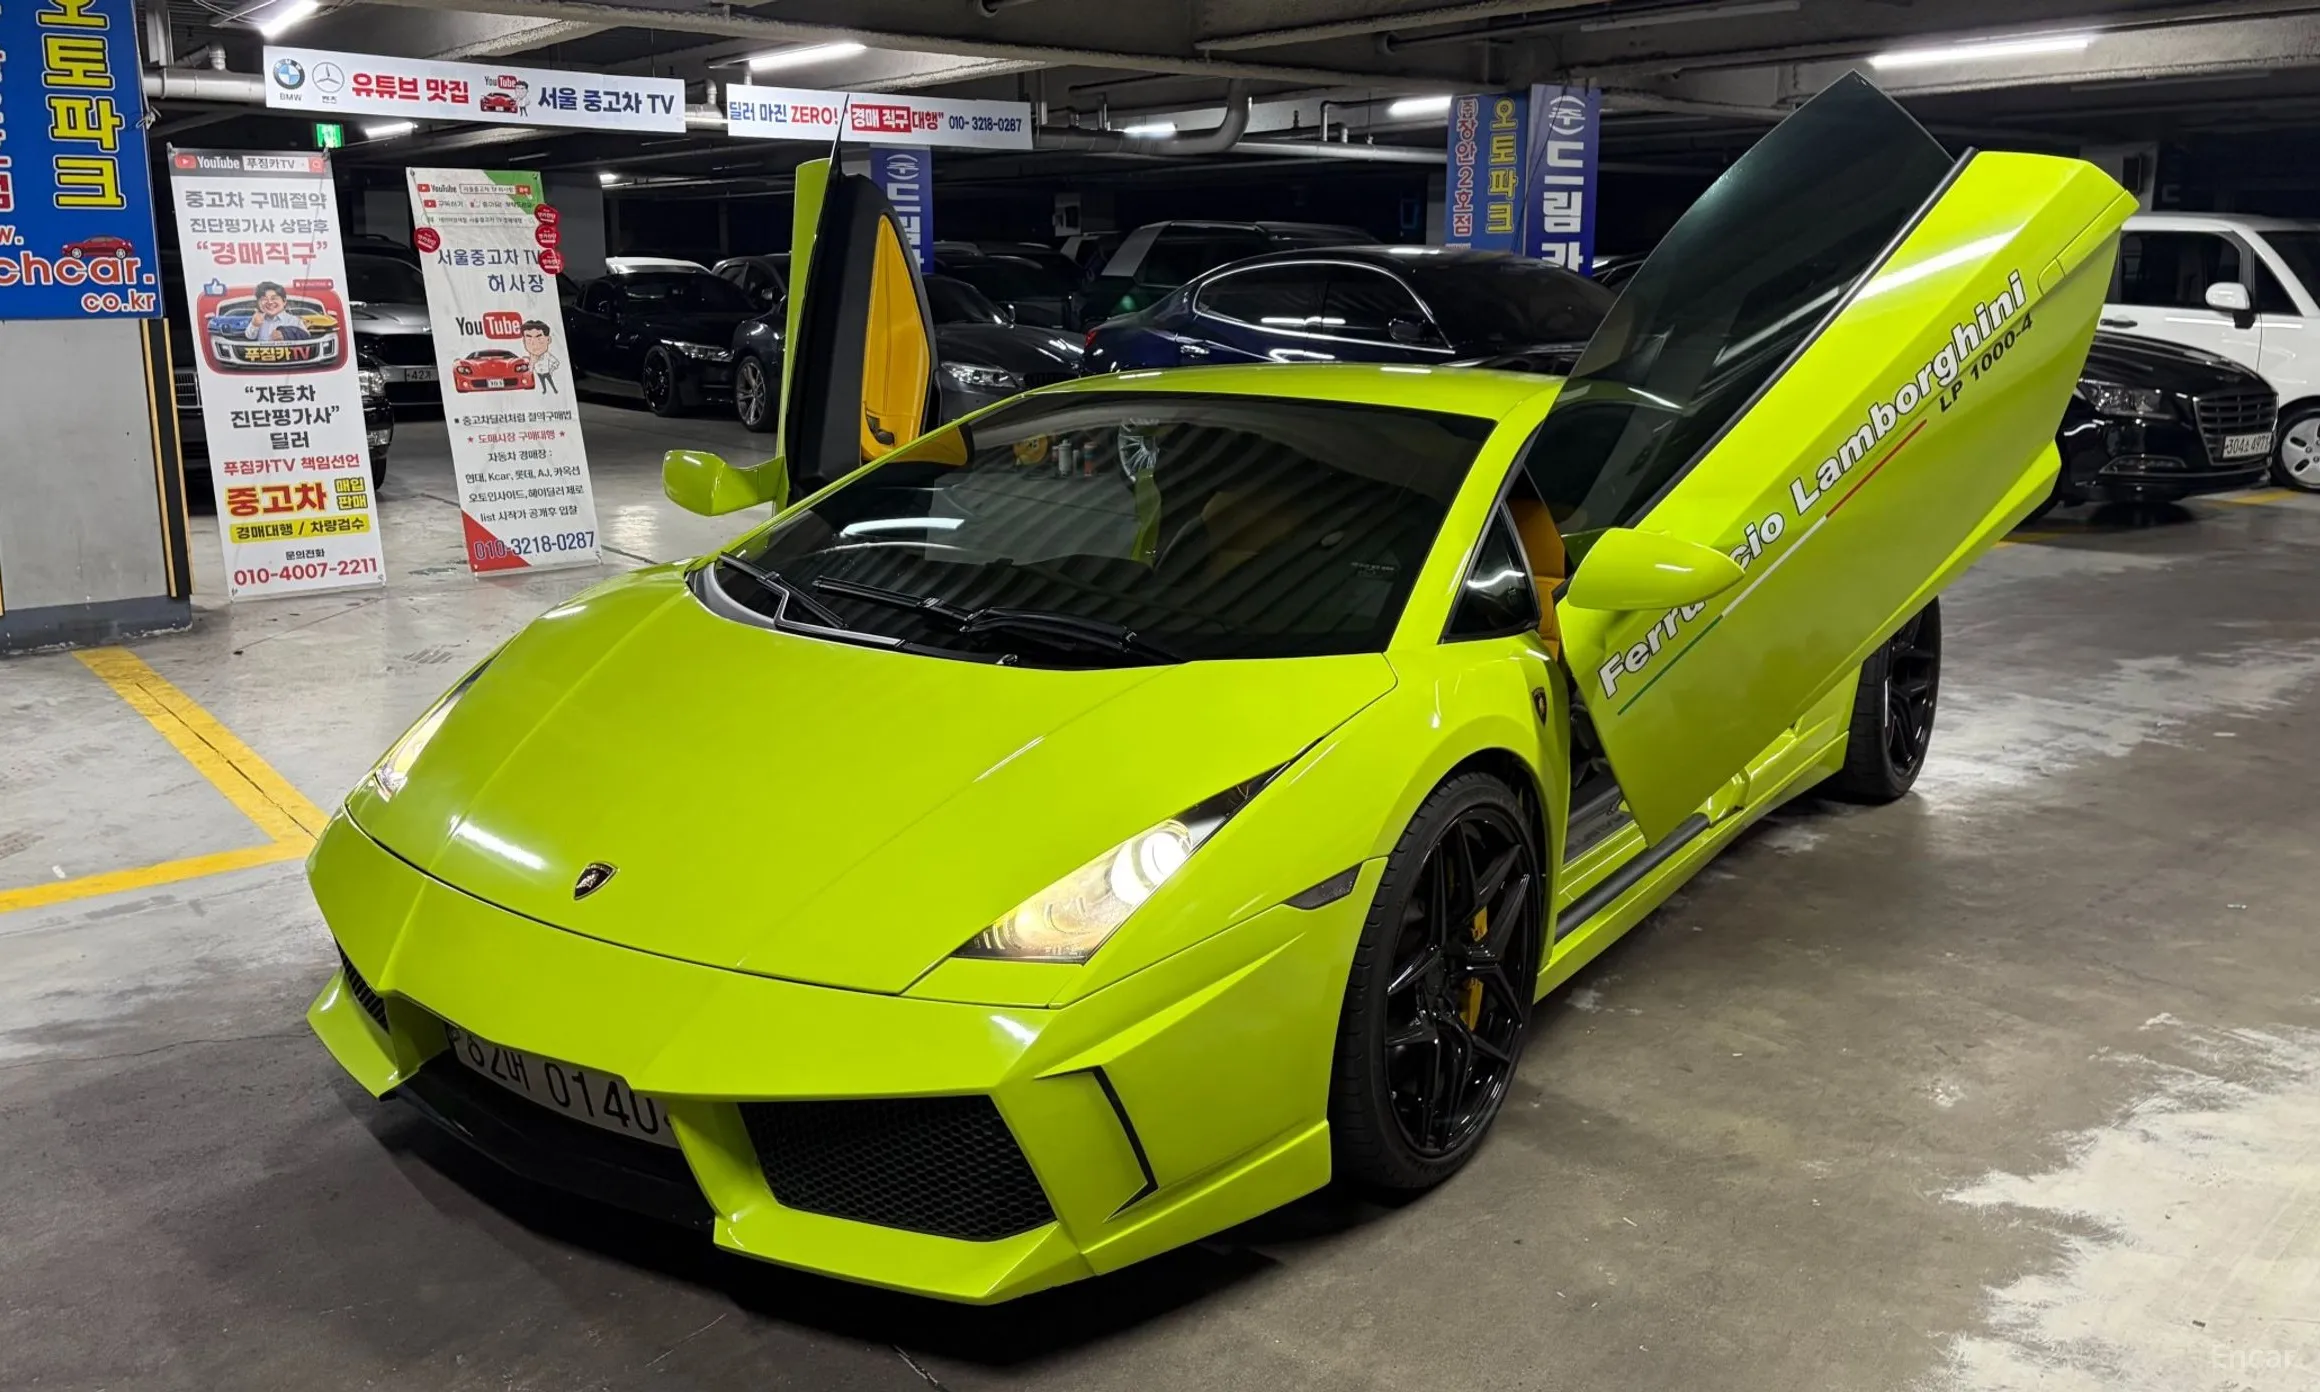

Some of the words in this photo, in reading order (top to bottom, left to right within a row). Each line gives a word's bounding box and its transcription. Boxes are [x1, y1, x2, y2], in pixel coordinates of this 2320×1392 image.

[279, 92, 302, 102] BMW
[352, 73, 420, 101] 유튜브
[425, 78, 470, 104] 맛집
[538, 86, 578, 111] 서울
[583, 89, 642, 114] 중고차
[646, 94, 675, 115] TV
[729, 101, 755, 122] 딜러
[760, 103, 788, 123] 마진
[790, 105, 839, 125] ZERO!
[197, 155, 241, 169] YouTube
[246, 158, 295, 170] 푸짐카TV
[1486, 97, 1519, 234] 오토파크
[185, 190, 245, 209] 중고차
[251, 192, 328, 210] 구매절약
[189, 218, 275, 234] 진단평가사
[280, 218, 329, 234] 상담후
[438, 249, 519, 266] 서울중고차
[524, 250, 540, 265] TV
[81, 290, 155, 312] co.kr
[455, 316, 521, 336] YouTube
[244, 346, 311, 362] 푸짐카TV
[1939, 380, 1963, 412] LP
[1970, 312, 2033, 381] 1000-4
[1790, 269, 2026, 516] Lamborghini
[270, 431, 310, 450] 딜러
[223, 458, 296, 477] 푸짐카TV
[300, 453, 360, 470] 책임선언
[487, 450, 516, 462] 자동차
[334, 476, 366, 493] 매입
[566, 484, 584, 495] 제로
[226, 481, 328, 518] 중고차
[337, 493, 368, 511] 판매
[480, 512, 496, 523] list
[498, 508, 527, 522] 시작가
[529, 506, 558, 518] 공개후
[558, 504, 578, 516] 입찰
[236, 523, 293, 540] 경매대행
[311, 517, 365, 533] 차량검수
[285, 548, 325, 561] 문의전화
[474, 530, 595, 560] 010-3218-0287
[233, 557, 378, 586] 010-4007-2211
